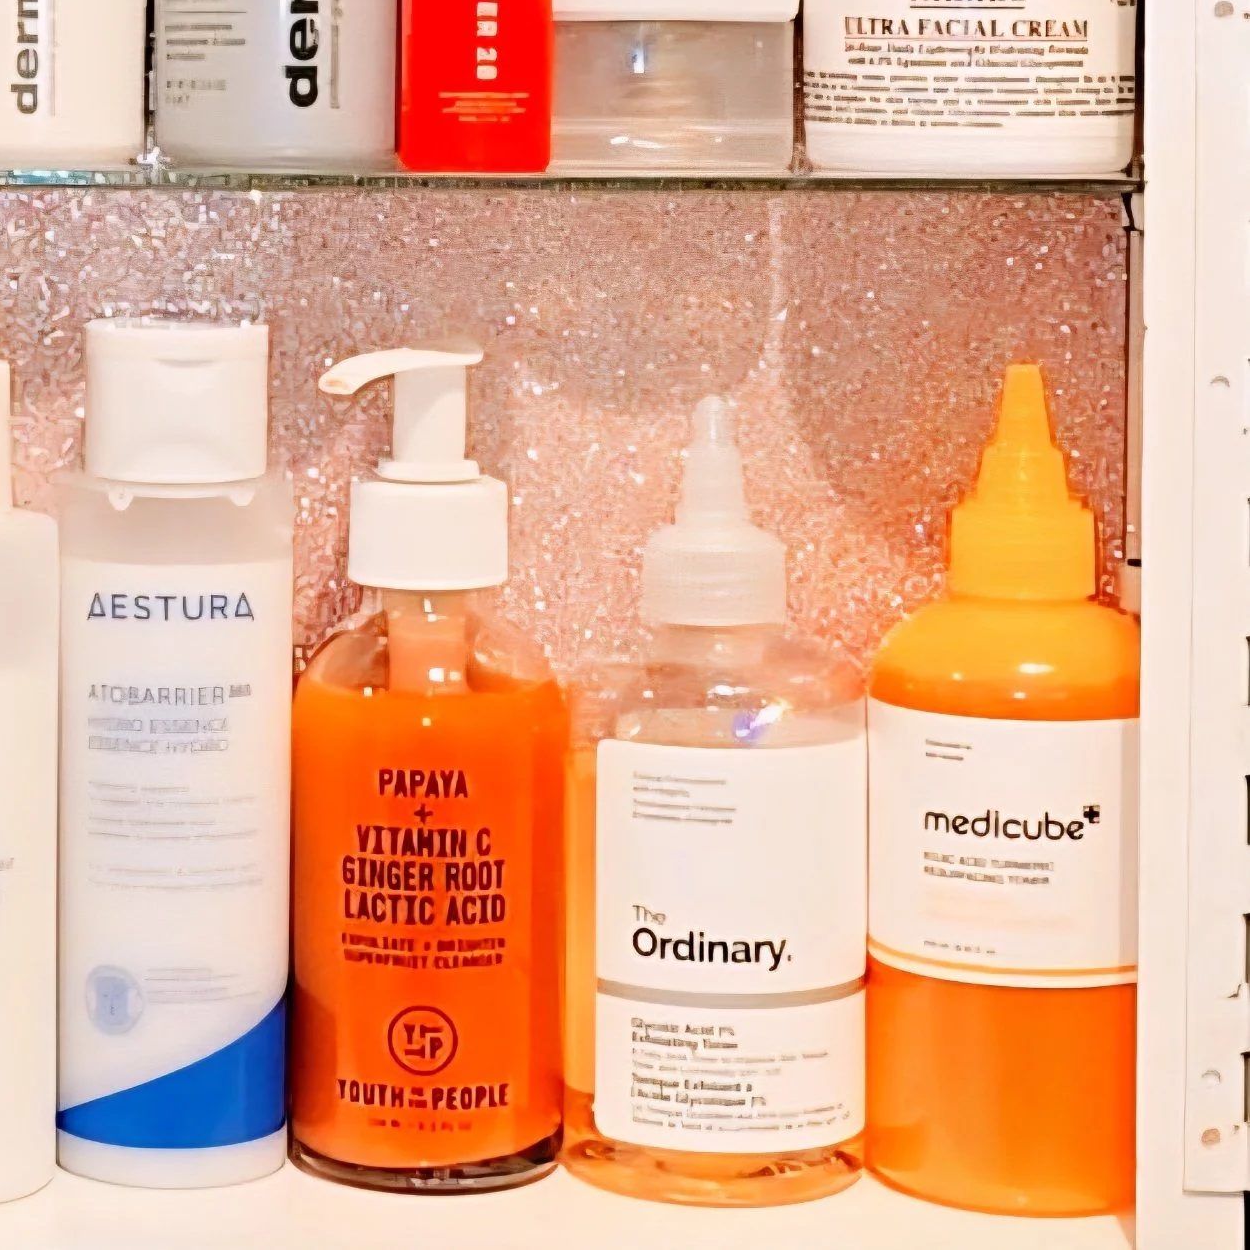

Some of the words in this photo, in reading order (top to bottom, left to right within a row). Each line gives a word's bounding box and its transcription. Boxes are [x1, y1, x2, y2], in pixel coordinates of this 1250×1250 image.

[845, 16, 910, 37] ULTRA
[918, 18, 1005, 38] FACIAL
[1012, 18, 1088, 38] CREAM
[87, 592, 255, 621] AESTURA
[378, 768, 468, 798] PAPAYA
[356, 824, 467, 857] VITAMIN
[476, 827, 491, 857] C
[924, 809, 1085, 841] medicube
[342, 855, 435, 891] GINGER
[445, 859, 506, 892] ROOT
[344, 888, 435, 925] LACTIC
[446, 893, 506, 926] ACID
[632, 927, 792, 972] Ordinary.
[337, 1079, 404, 1108] YOUTH
[431, 1083, 509, 1110] PEOPLE
